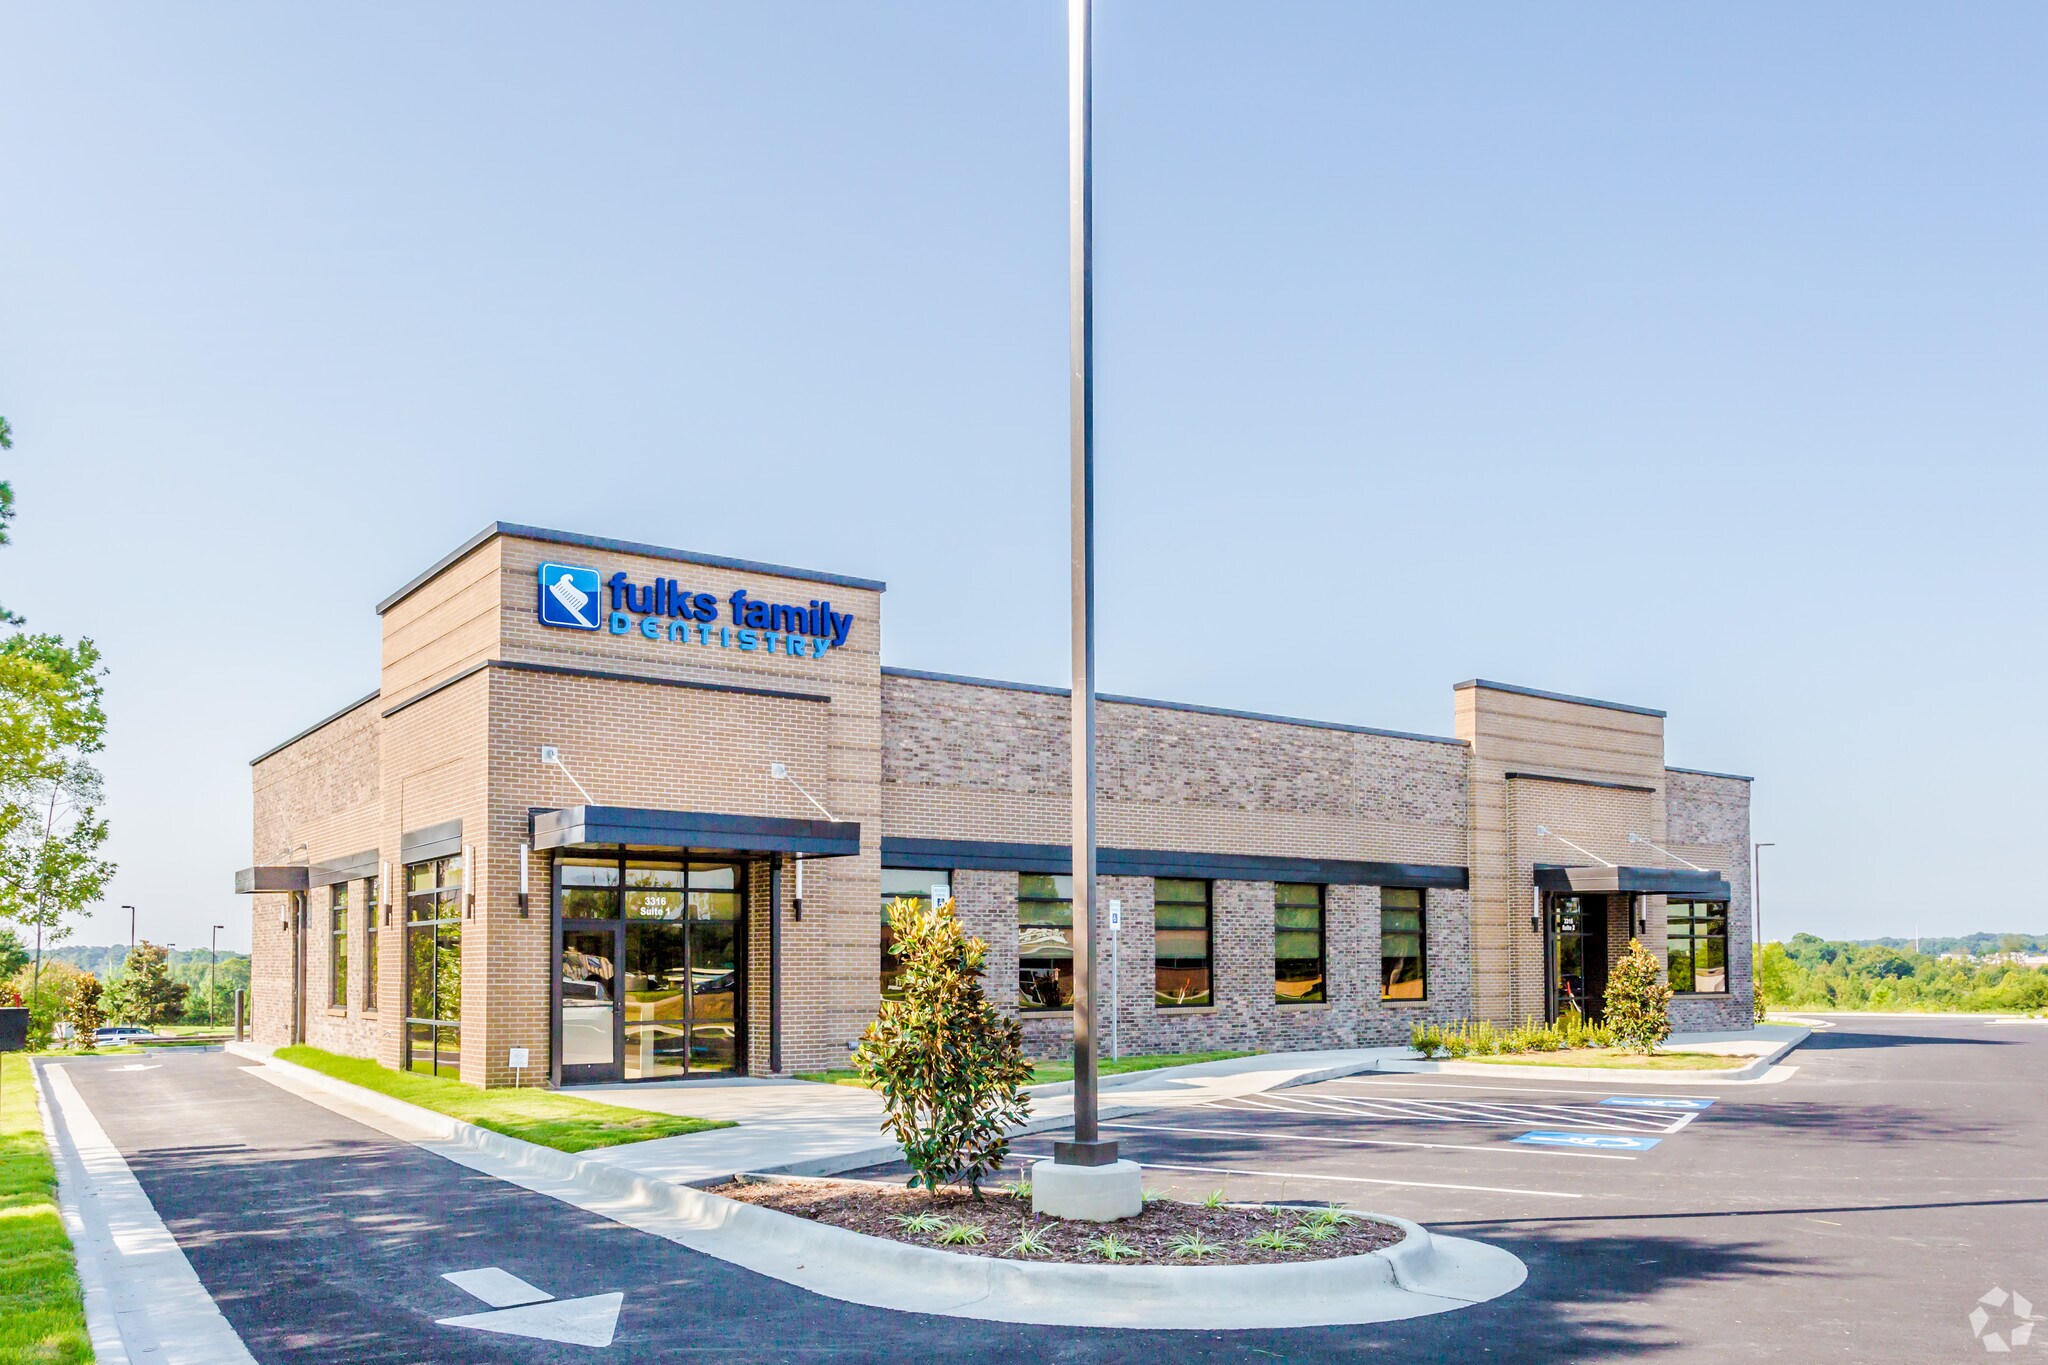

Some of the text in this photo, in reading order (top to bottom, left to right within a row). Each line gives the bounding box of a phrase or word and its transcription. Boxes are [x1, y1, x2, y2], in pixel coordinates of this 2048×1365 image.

[608, 571, 854, 647] fulks family
[609, 611, 832, 659] DENTISTRY
[640, 906, 671, 916] Suite 1
[644, 896, 667, 906] 3316
